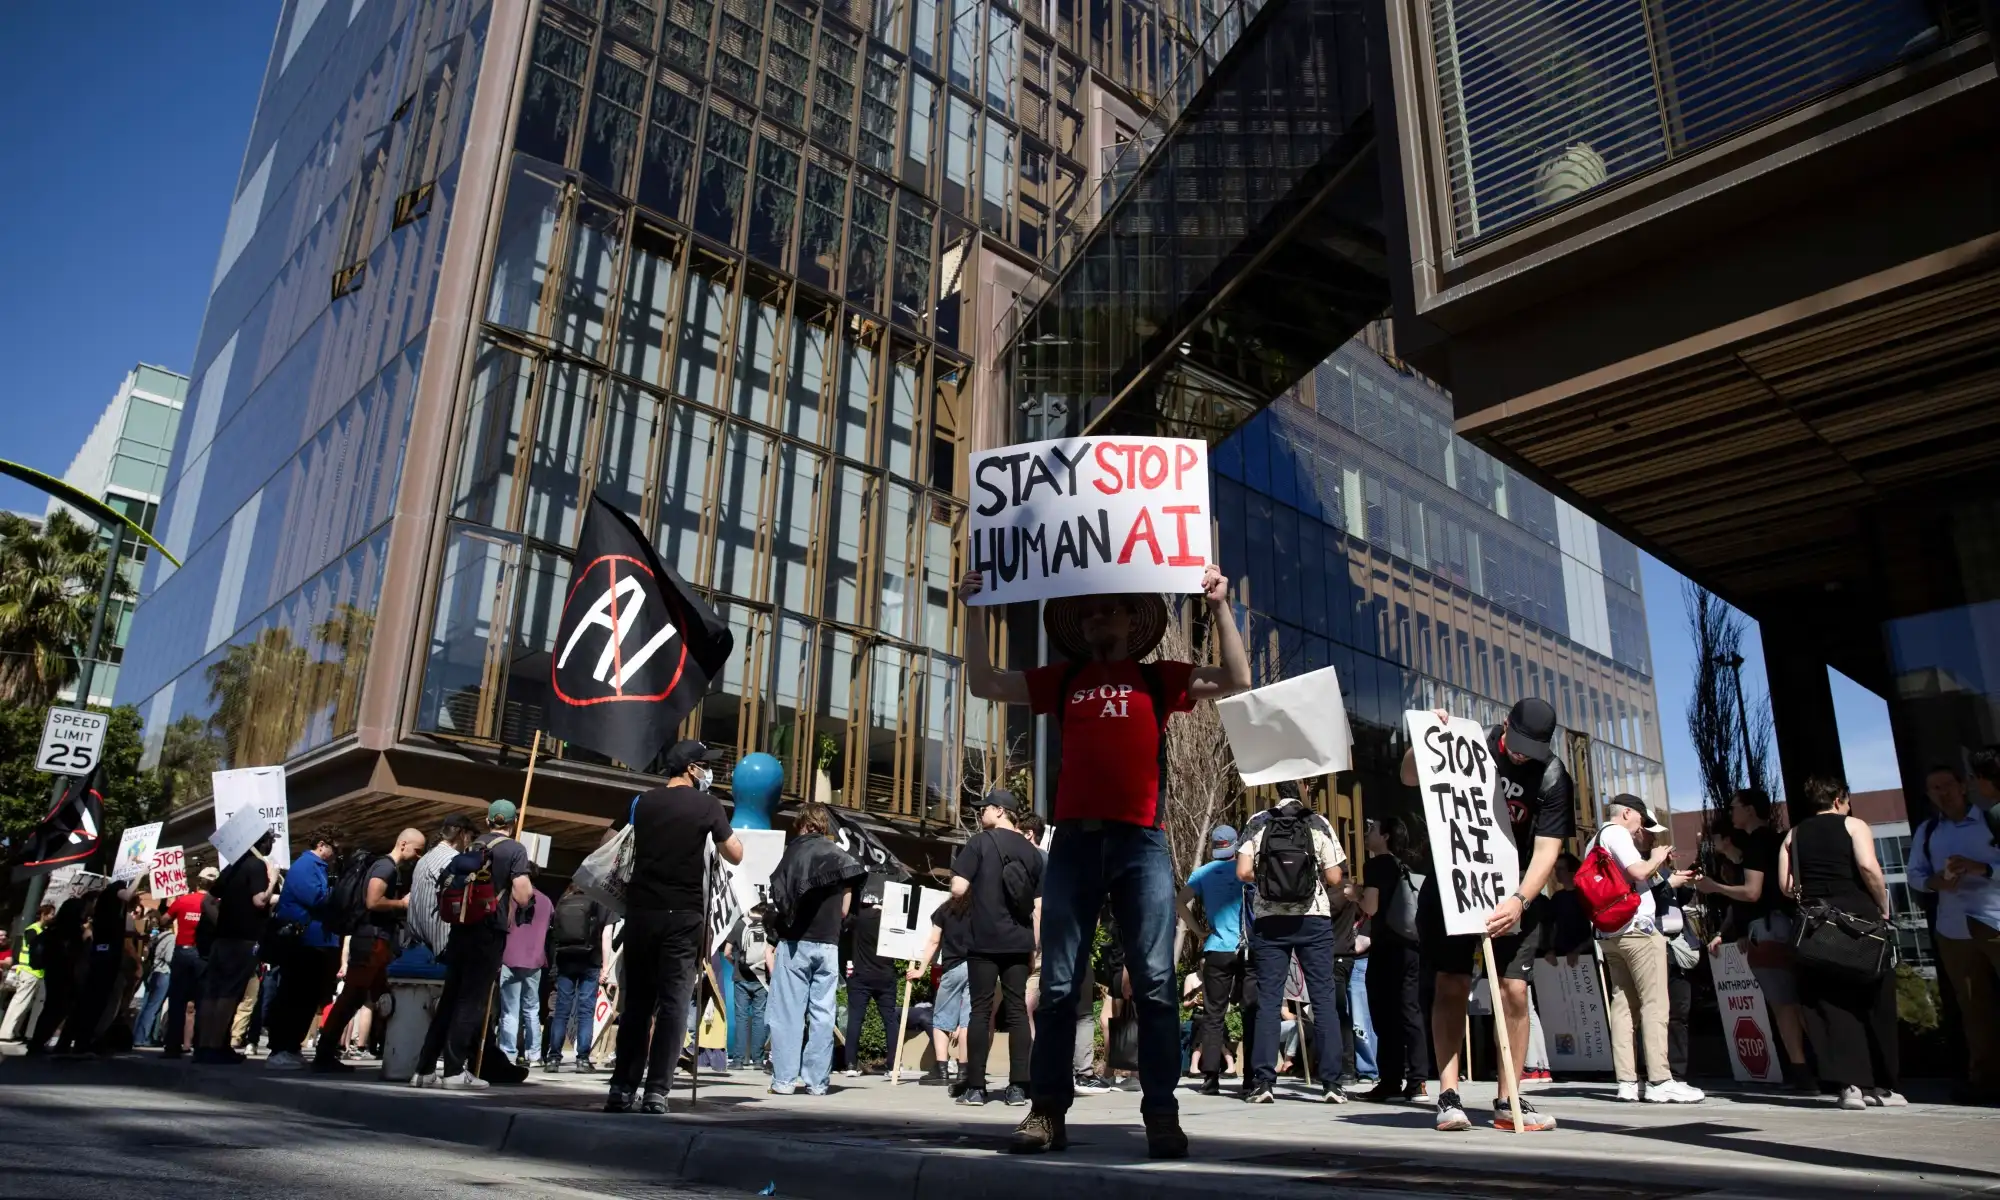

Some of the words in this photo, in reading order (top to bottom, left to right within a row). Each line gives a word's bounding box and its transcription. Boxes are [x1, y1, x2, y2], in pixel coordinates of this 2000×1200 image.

[975, 442, 1092, 517] STAY
[1092, 441, 1199, 496] STOP
[974, 508, 1112, 591] HUMAN
[1117, 504, 1205, 567] AI
[1072, 683, 1133, 705] STOP
[1100, 699, 1130, 718] AI
[53, 713, 100, 729] SPEED
[54, 728, 93, 742] LIMIT
[45, 743, 93, 769] 25
[1424, 725, 1488, 784] STOP
[1500, 776, 1524, 799] OP
[1430, 782, 1493, 827] THE
[1449, 818, 1494, 866] AI
[151, 850, 184, 870] STOP
[154, 868, 187, 890] RACING
[165, 883, 188, 896] NOW
[1451, 868, 1506, 914] RACE
[1581, 964, 1595, 995] SLOW
[1590, 1003, 1598, 1012] &
[1594, 1020, 1604, 1055] STEADY
[1728, 995, 1755, 1011] MUST
[1738, 1038, 1764, 1057] STOP
